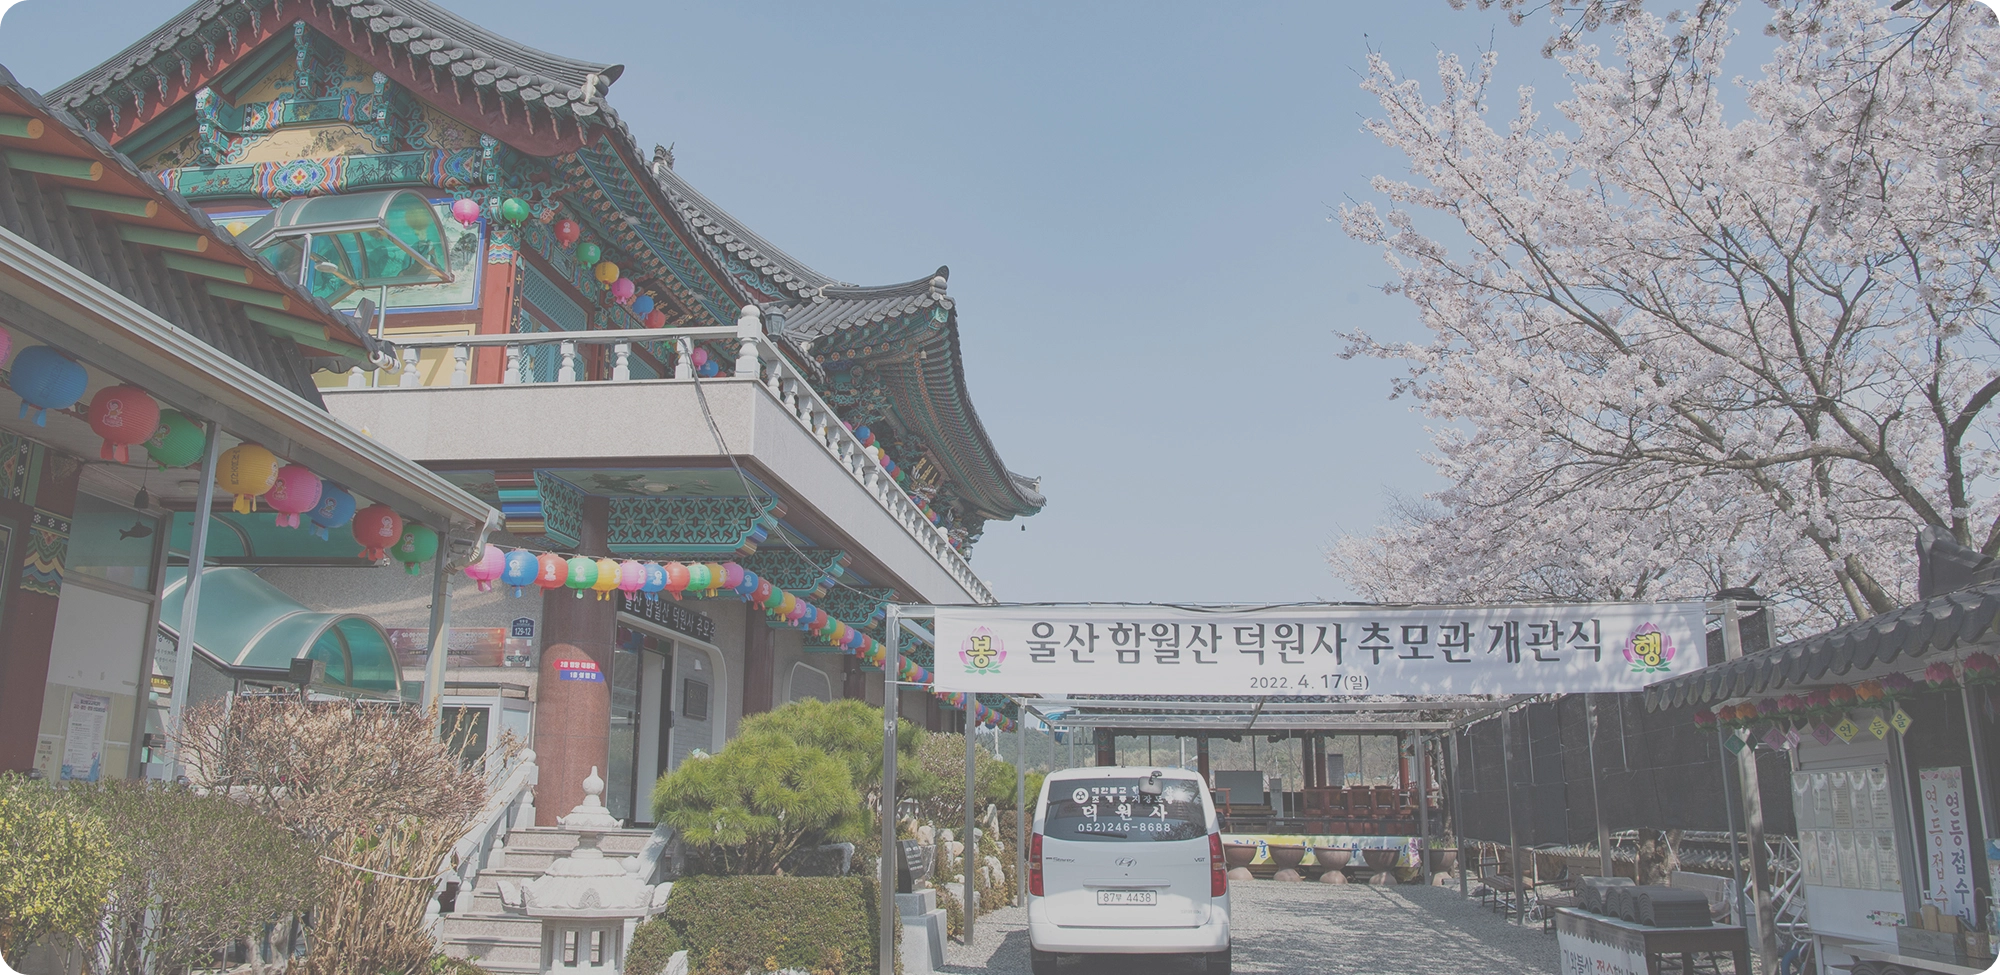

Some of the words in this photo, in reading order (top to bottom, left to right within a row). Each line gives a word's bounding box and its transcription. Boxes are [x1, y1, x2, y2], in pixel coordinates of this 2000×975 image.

[515, 627, 531, 636] 129-12
[1026, 621, 1100, 664] 울산
[1108, 621, 1223, 665] 함월산
[1233, 622, 1347, 666] 덕원사
[1357, 621, 1475, 665] 추모관
[1486, 618, 1602, 664] 개관식
[1632, 631, 1662, 668] 행
[965, 635, 998, 669] 봉
[1250, 676, 1293, 690] 2022.
[1321, 673, 1370, 691] 17(일)
[1081, 803, 1168, 822] 덕원사
[1077, 822, 1171, 832] 052)246-8688
[1126, 893, 1152, 903] 4438
